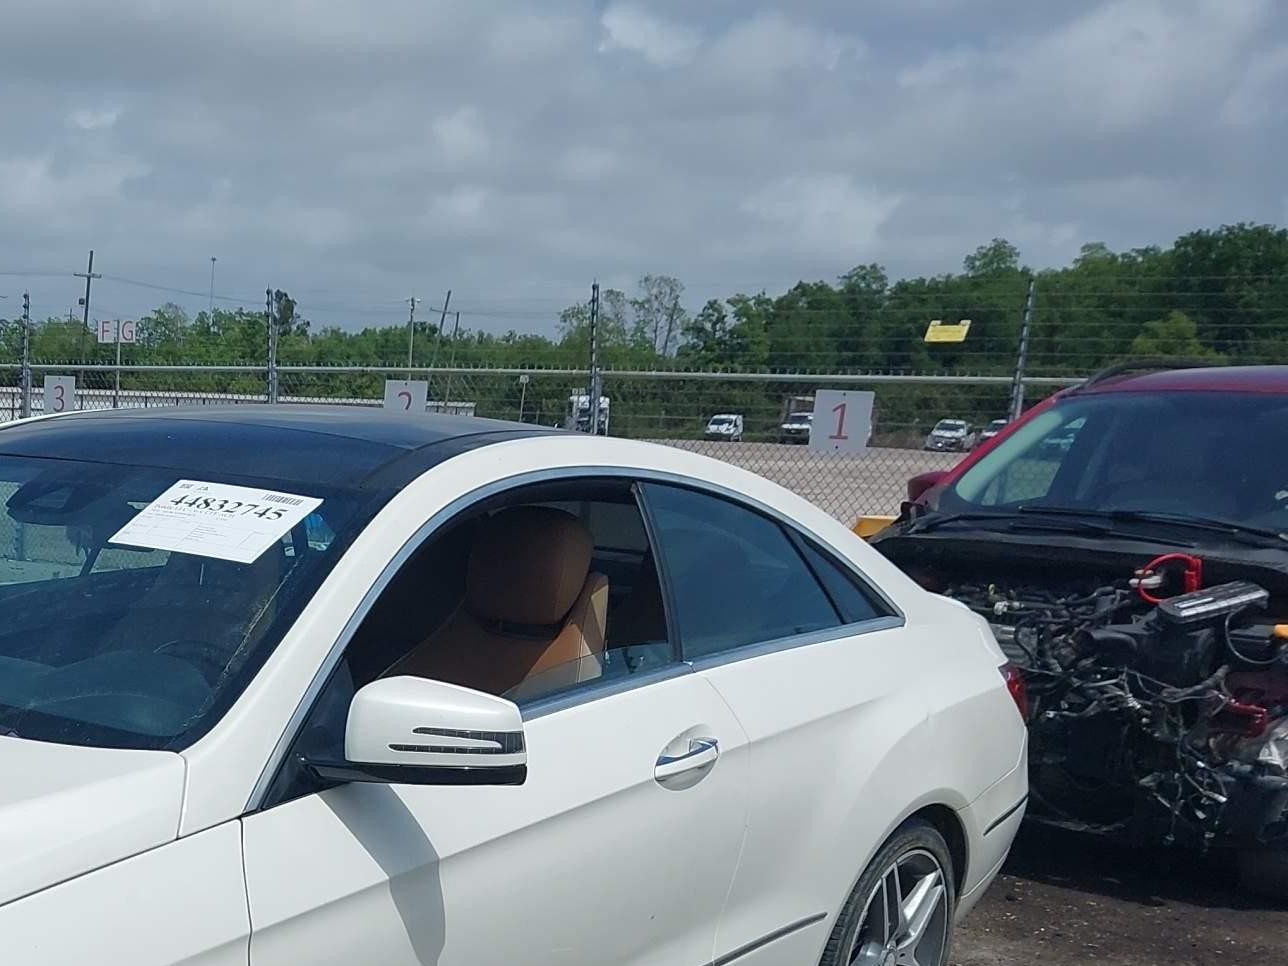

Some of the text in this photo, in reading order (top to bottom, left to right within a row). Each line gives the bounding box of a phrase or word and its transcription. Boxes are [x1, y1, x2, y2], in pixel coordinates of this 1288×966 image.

[100, 320, 111, 341] F
[121, 320, 134, 341] G
[52, 385, 66, 412] 3
[829, 403, 849, 440] 1
[169, 494, 290, 521] 44832745
